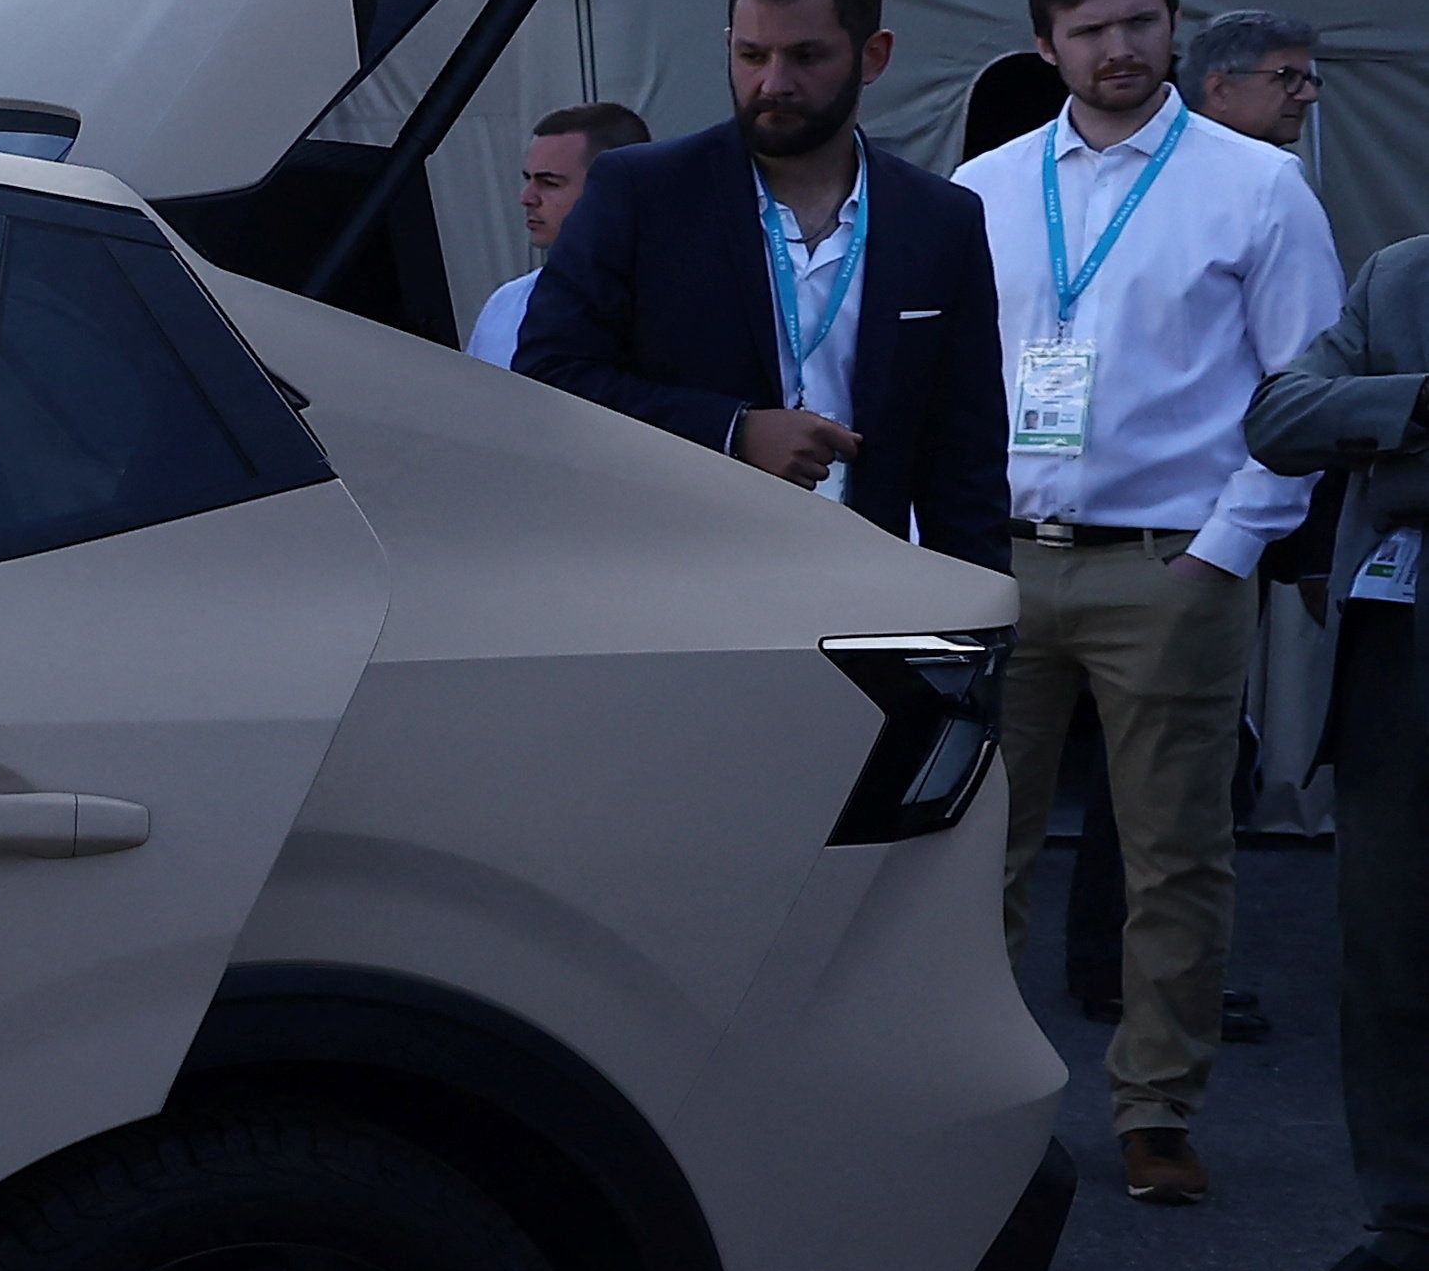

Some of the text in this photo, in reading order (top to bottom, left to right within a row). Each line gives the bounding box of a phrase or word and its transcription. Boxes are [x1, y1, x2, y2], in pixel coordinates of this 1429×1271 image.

[1113, 193, 1139, 228] THALES
[771, 228, 786, 271] THALES
[841, 237, 861, 278] THALES
